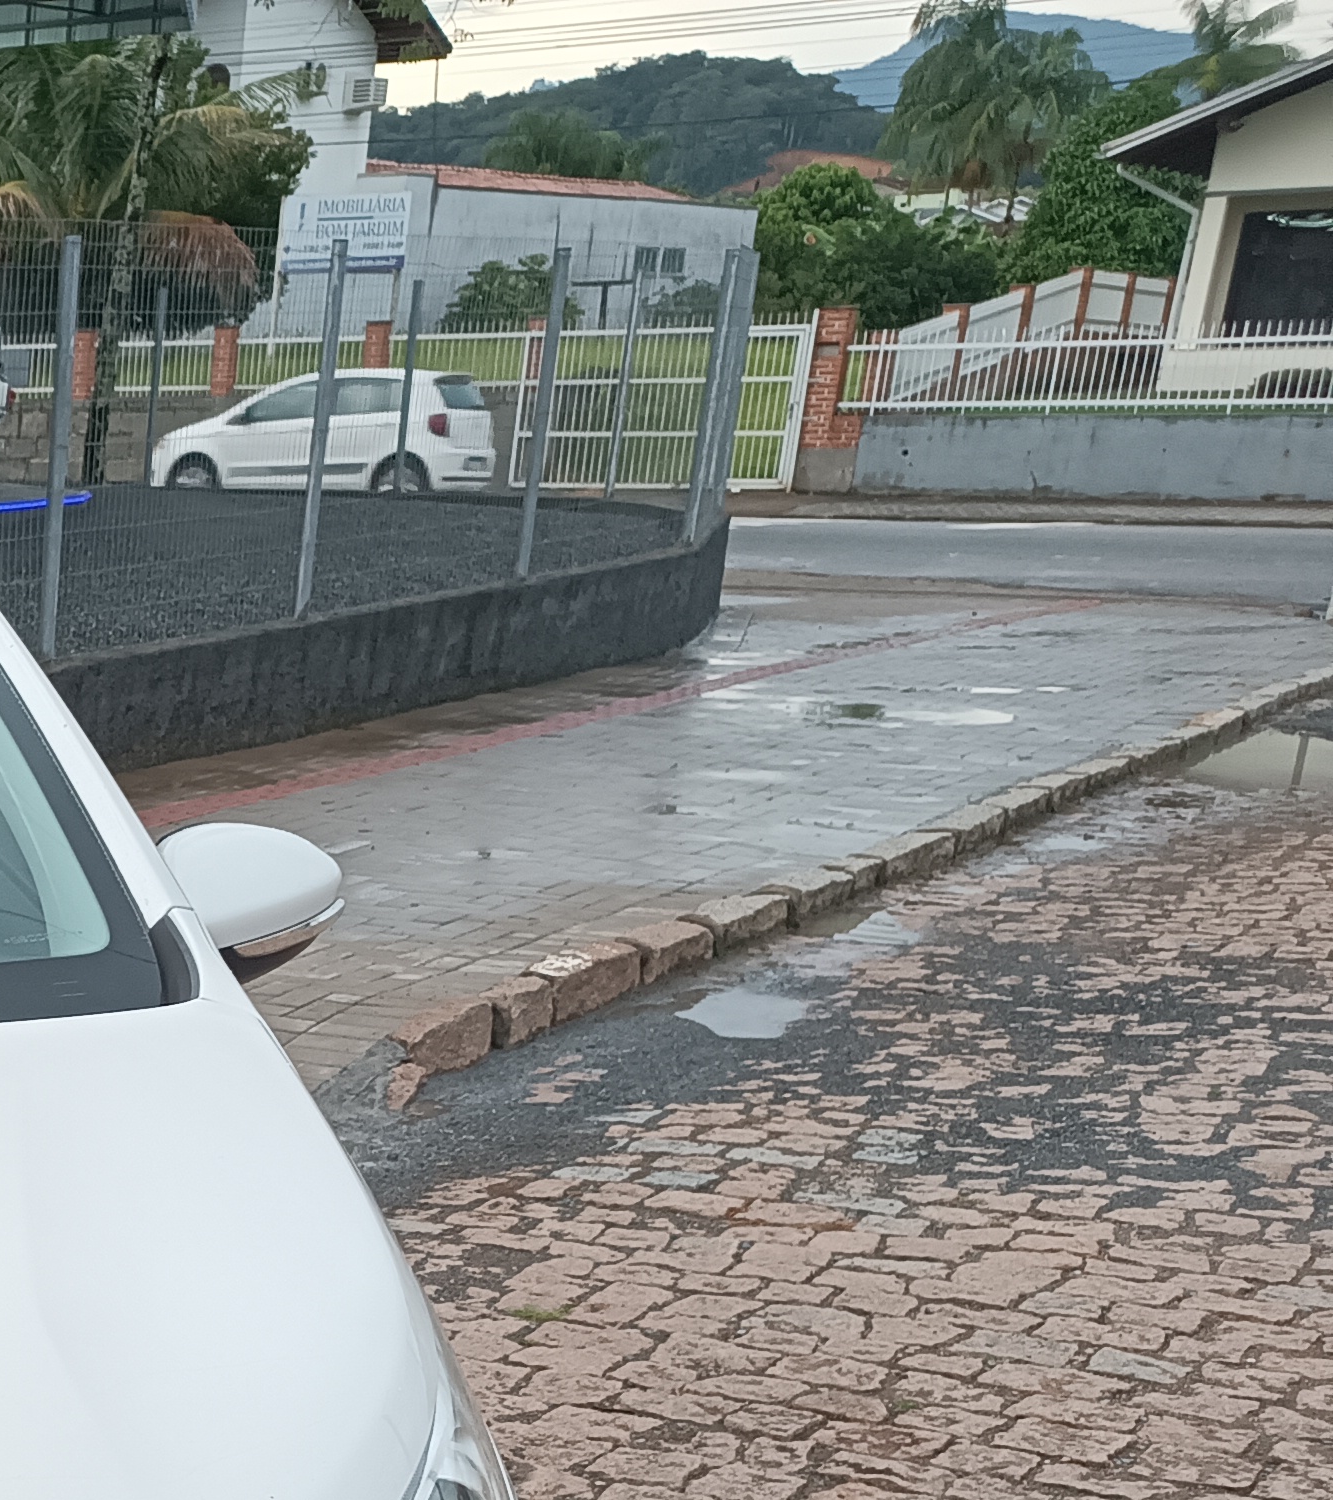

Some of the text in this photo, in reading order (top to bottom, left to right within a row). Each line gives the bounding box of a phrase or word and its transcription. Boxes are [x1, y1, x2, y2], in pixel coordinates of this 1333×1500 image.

[317, 195, 406, 215] IMOBILIÁRIA
[315, 220, 404, 241] BOM JARDIM
